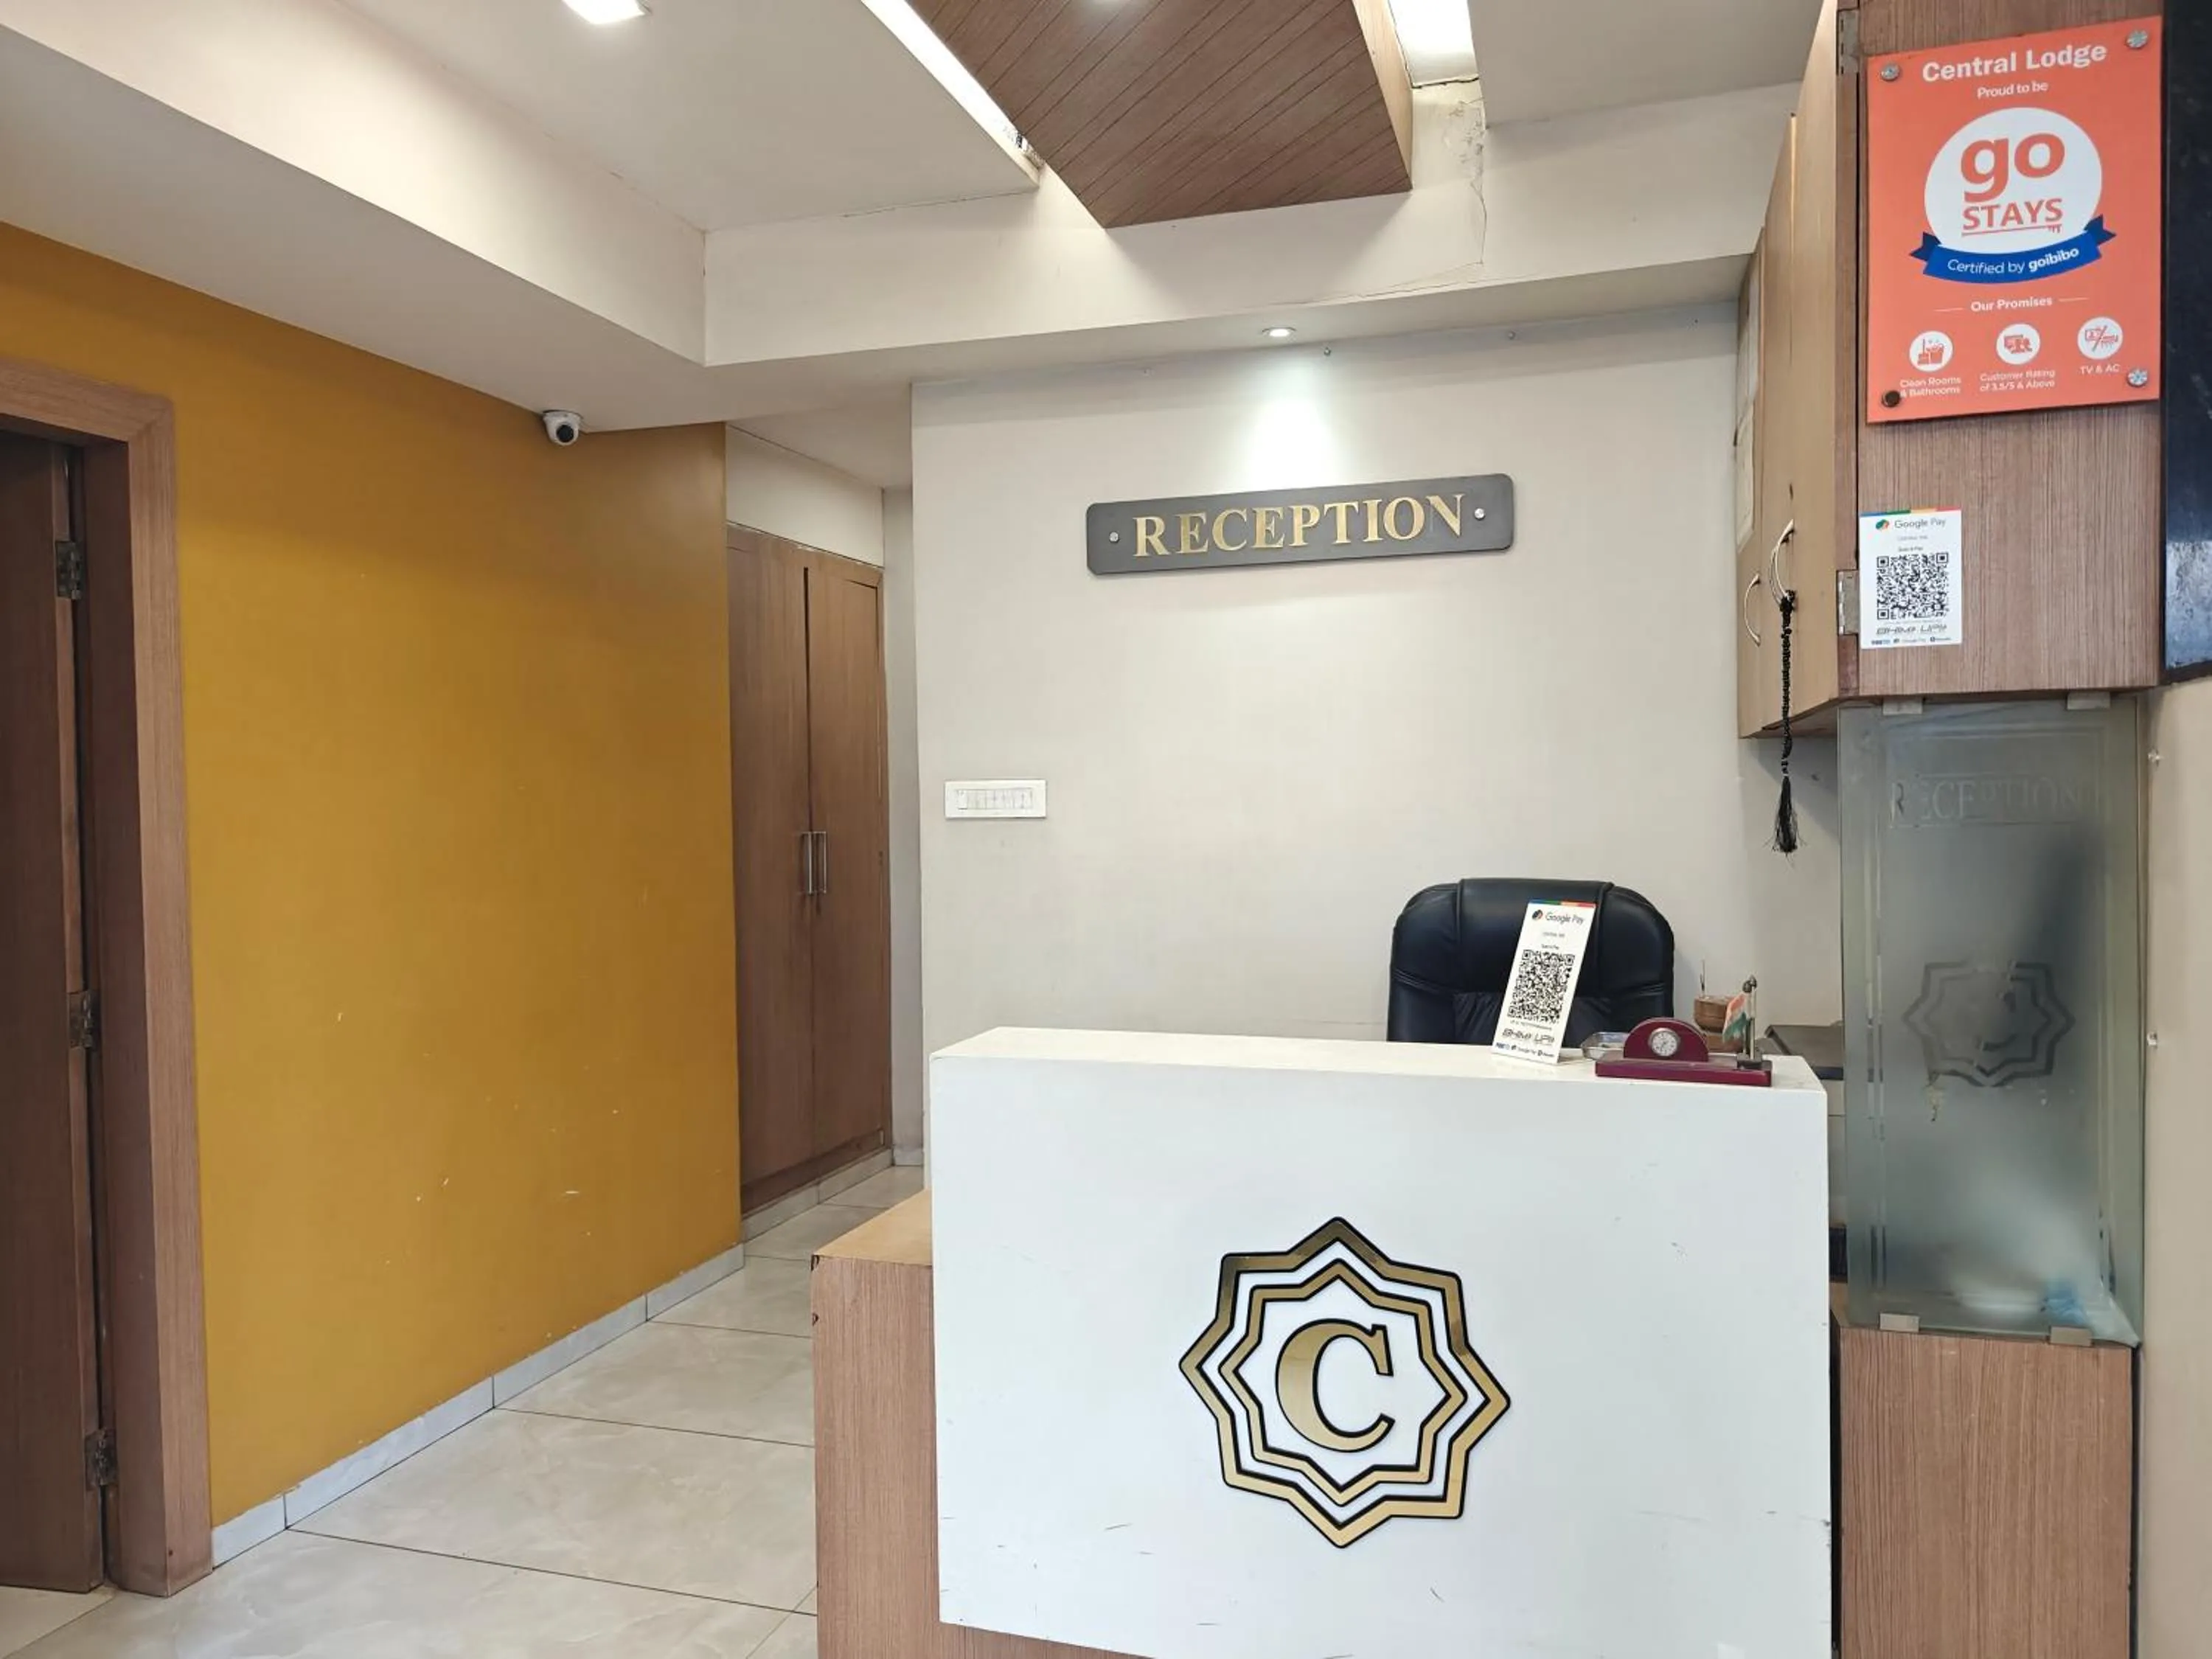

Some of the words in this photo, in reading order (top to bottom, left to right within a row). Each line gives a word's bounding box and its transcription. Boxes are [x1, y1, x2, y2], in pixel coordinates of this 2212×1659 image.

[1922, 52, 2017, 82] Central
[2025, 44, 2107, 69] Lodge
[1978, 83, 2014, 99] Proud
[2017, 83, 2030, 95] to
[2031, 80, 2048, 93] be
[1961, 132, 2065, 202] go
[1962, 198, 2063, 230] STAYS
[1947, 259, 2005, 275] Certified
[2008, 261, 2025, 274] by
[2028, 247, 2080, 272] goibibo
[1971, 300, 1994, 312] Our
[1997, 296, 2053, 310] Promises
[1980, 372, 2023, 382] Customer
[2025, 369, 2056, 379] Rating
[2079, 365, 2093, 375] TV
[2105, 364, 2121, 373] AC
[1899, 378, 1927, 388] Clean
[1928, 376, 1961, 386] Rooms
[1980, 383, 1989, 392] of
[2025, 379, 2056, 389] Above
[1909, 386, 1961, 397] Bathrooms
[1133, 493, 1465, 557] RECEPTION
[1894, 519, 1928, 530] Google
[1930, 517, 1947, 528] Pay
[1545, 911, 1571, 925] Google
[1275, 1318, 1396, 1453] C
